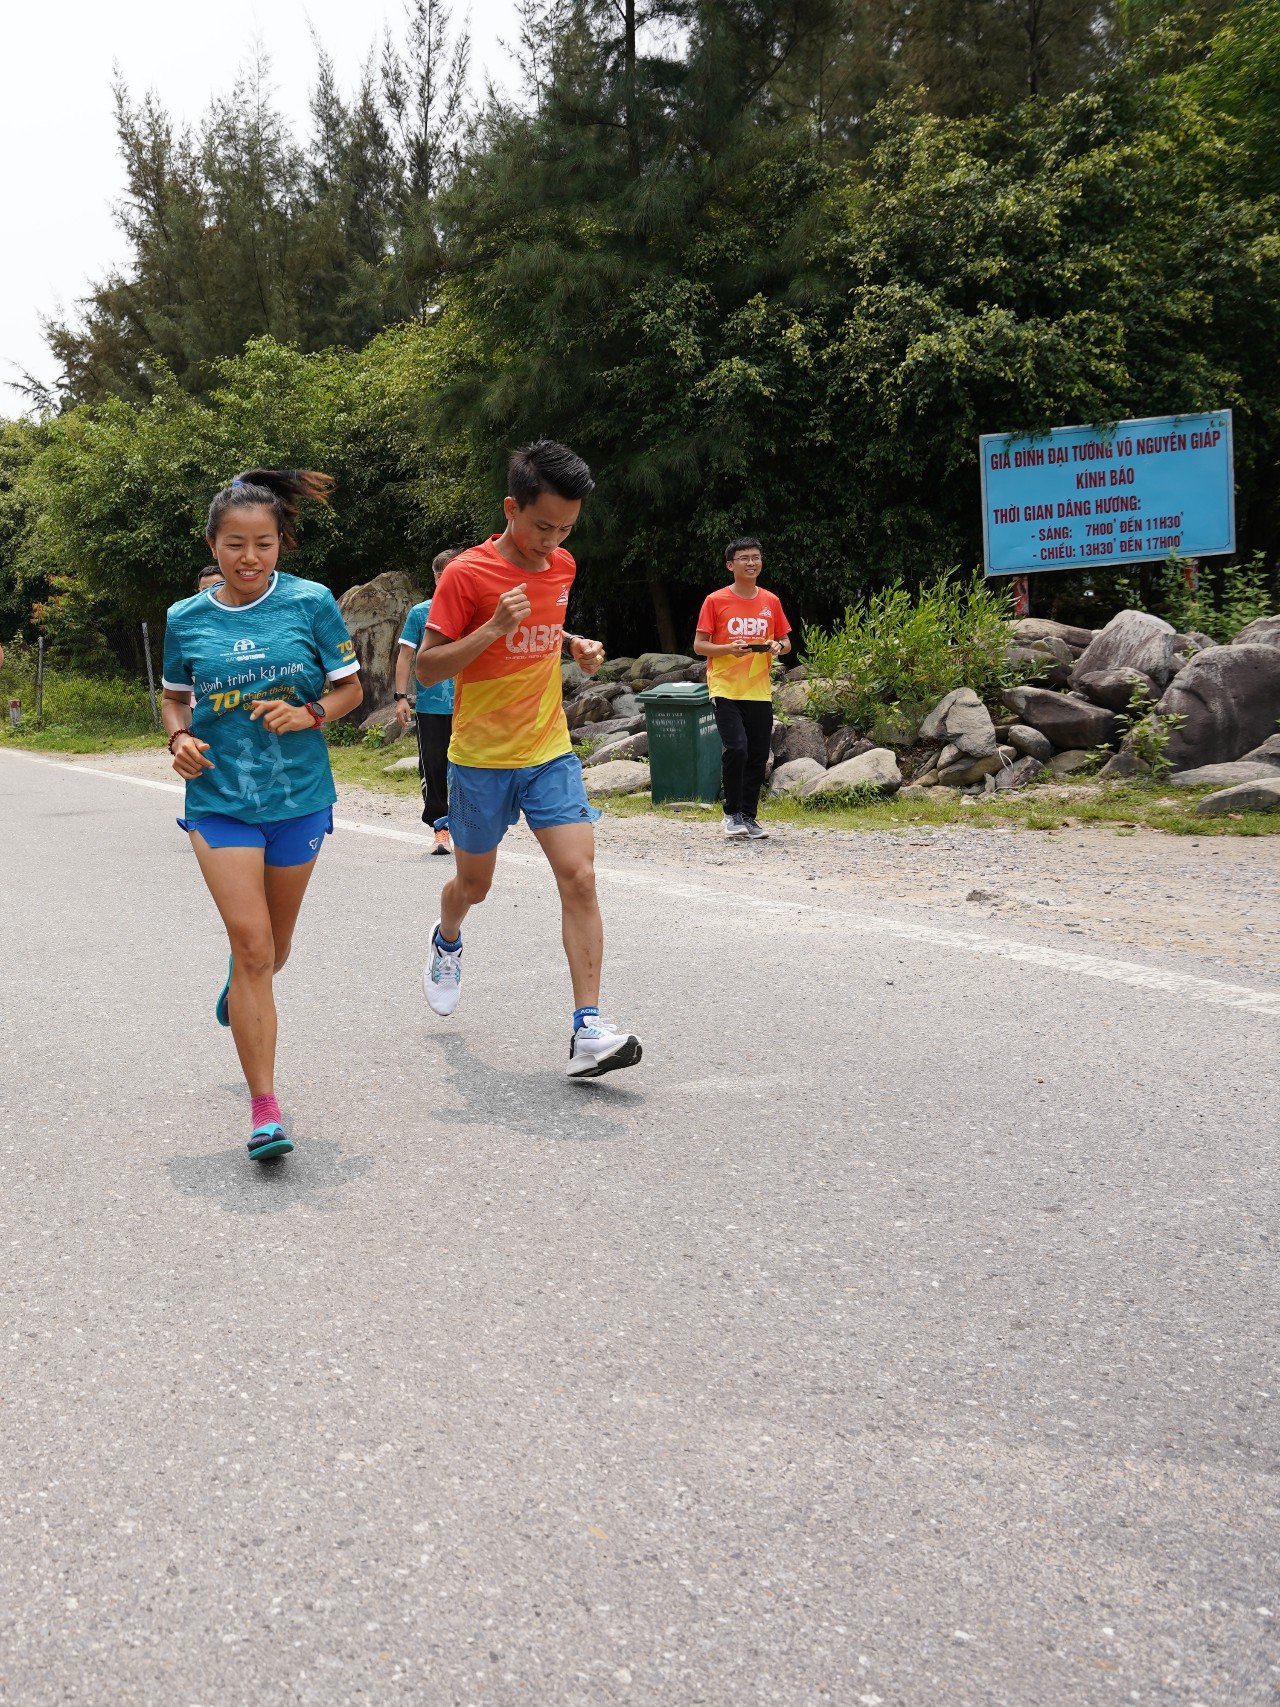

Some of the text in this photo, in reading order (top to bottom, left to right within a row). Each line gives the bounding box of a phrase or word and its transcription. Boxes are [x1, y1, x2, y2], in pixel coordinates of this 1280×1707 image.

[991, 452, 1011, 470] GIA
[1014, 447, 1044, 468] ĐÌNH
[1048, 446, 1068, 467] ĐẠI
[1116, 436, 1132, 458] VÕ
[1136, 431, 1187, 455] NGUYÊN
[1190, 427, 1221, 450] GIÁP
[1076, 465, 1135, 489] KÍNH BÁO
[993, 495, 1141, 525] THỜI GIAN DÂNG HƯƠNG:
[1038, 525, 1072, 541] SÁNG:
[1119, 515, 1143, 534] ĐẾN
[1119, 535, 1143, 553] ĐẾN
[727, 616, 769, 636] QBR
[336, 639, 353, 654] 70
[199, 677, 223, 694] Hành
[227, 669, 256, 687] trình
[280, 662, 304, 676] niệm
[208, 689, 240, 712] 70
